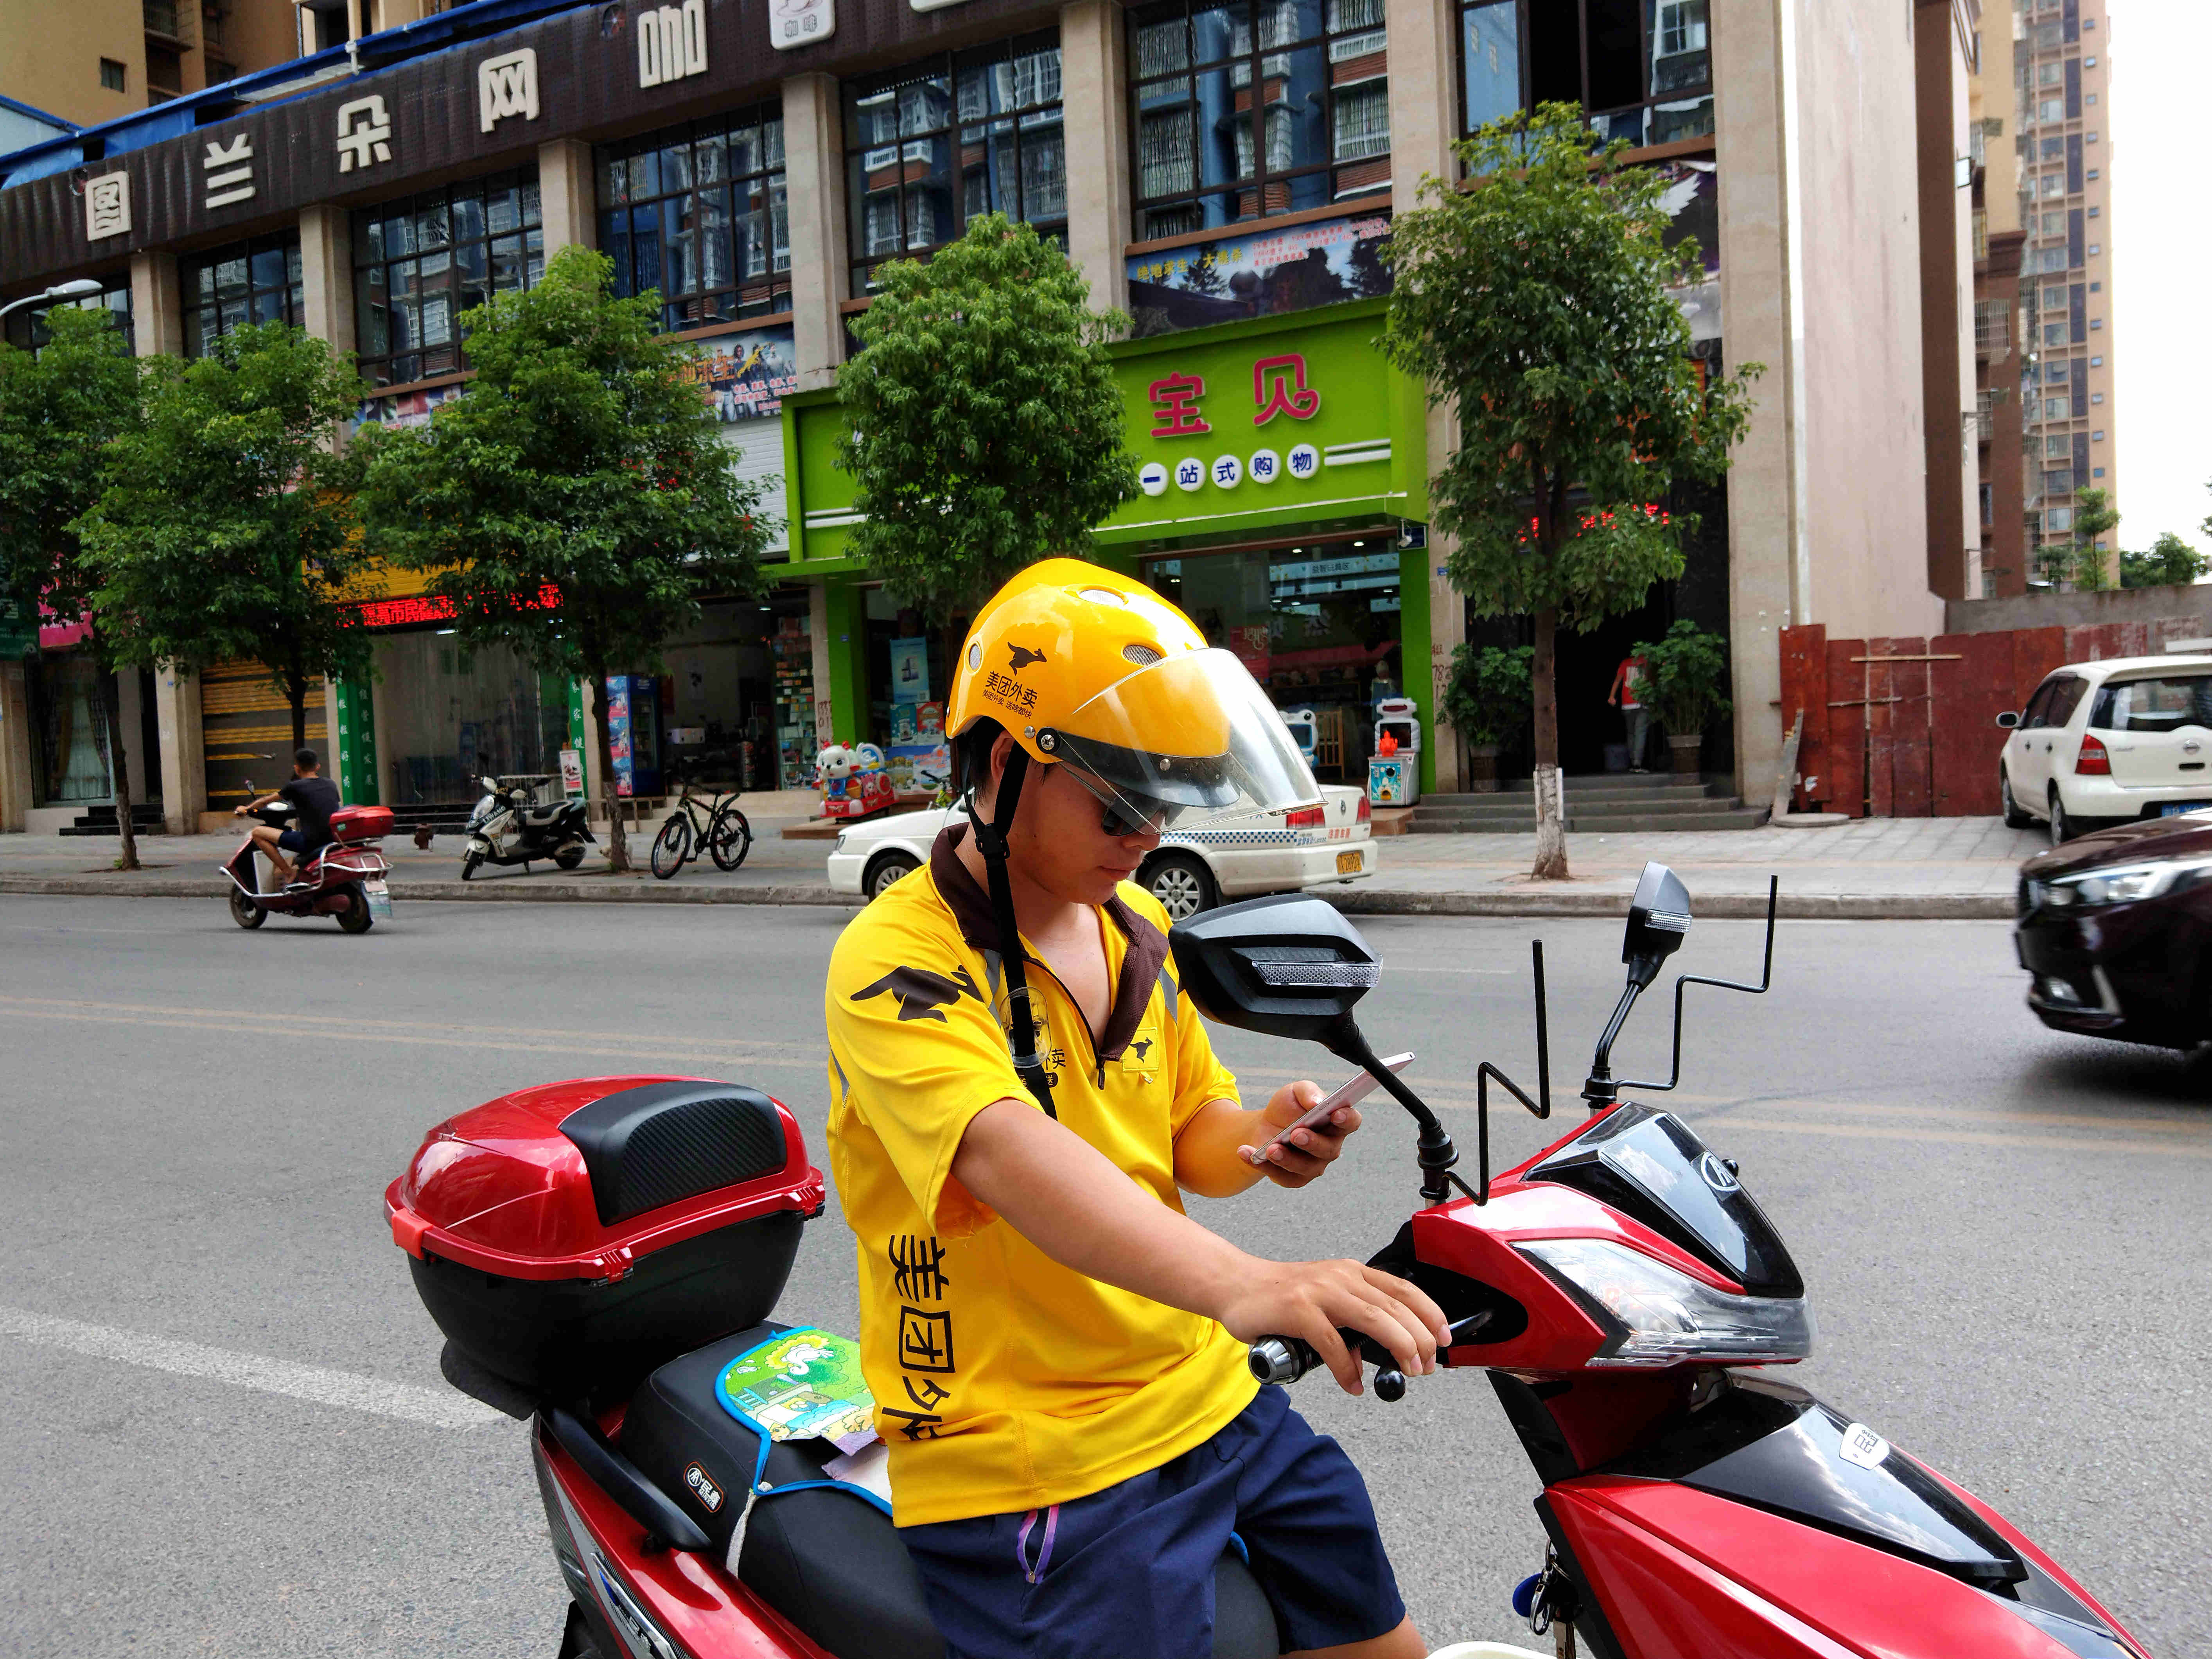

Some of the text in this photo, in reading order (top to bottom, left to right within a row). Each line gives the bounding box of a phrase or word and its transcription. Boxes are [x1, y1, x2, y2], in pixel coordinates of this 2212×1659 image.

[785, 13, 818, 38] 咖啡
[1149, 353, 1321, 438] 宝贝
[1143, 452, 1312, 485] 一站式购物
[982, 689, 1032, 719] 美团外卖 送啥都快
[986, 671, 1038, 709] 美团外卖
[698, 1488, 717, 1510] MINXIN
